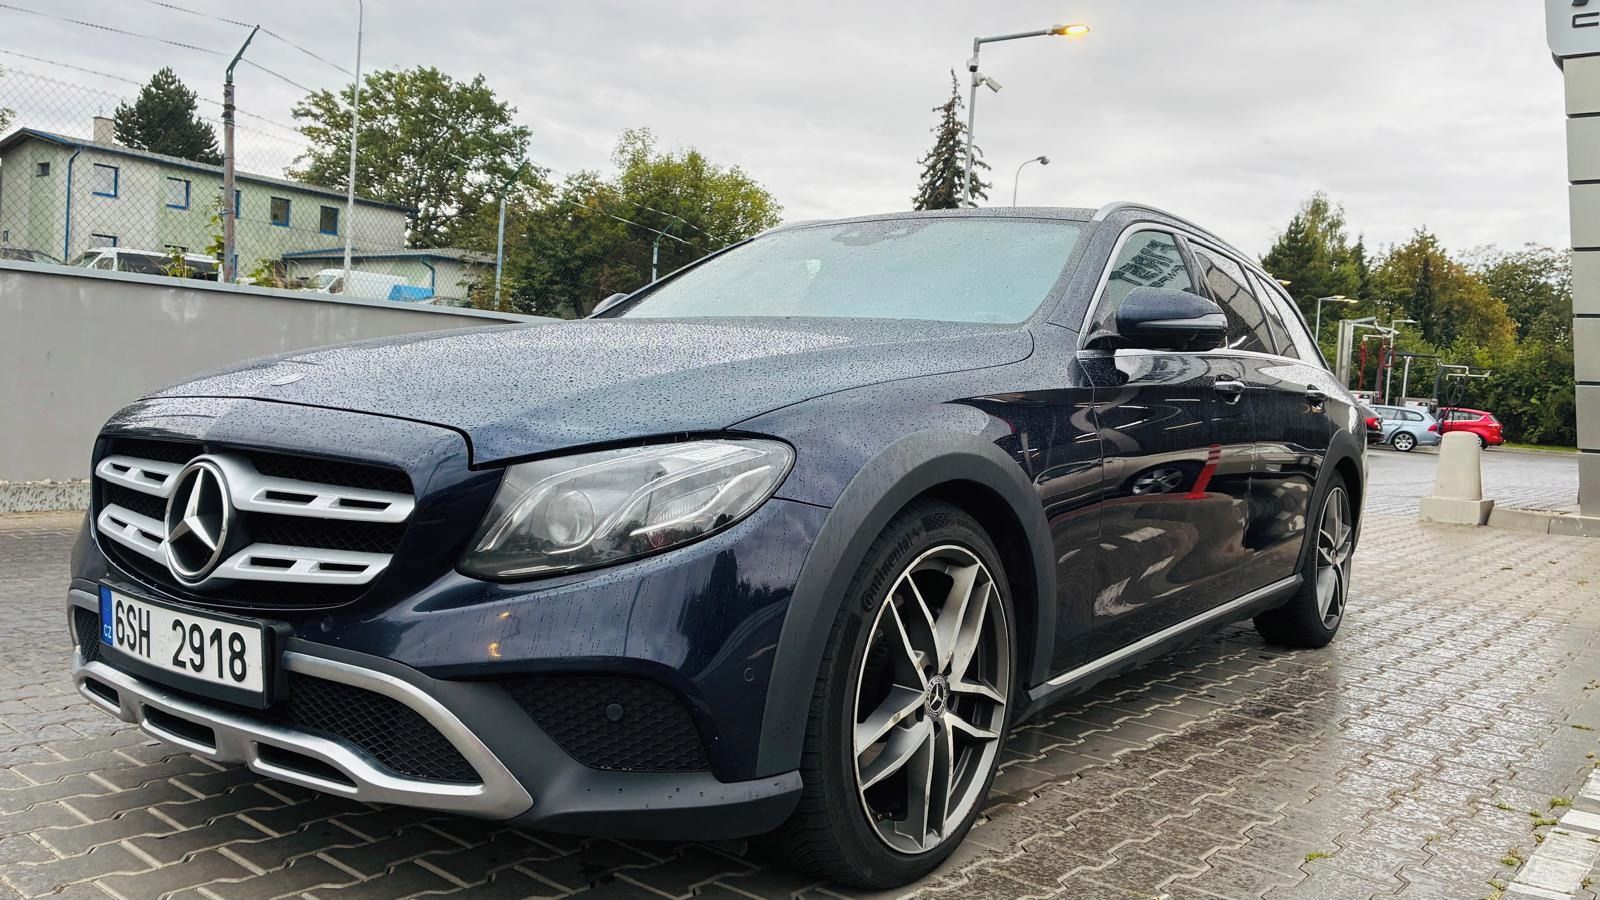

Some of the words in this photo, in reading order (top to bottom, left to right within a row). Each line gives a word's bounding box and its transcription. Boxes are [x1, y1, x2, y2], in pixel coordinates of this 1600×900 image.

[861, 532, 913, 612] Continental
[103, 624, 112, 639] CZ
[115, 599, 151, 659] 6SH
[171, 618, 247, 682] 2918
